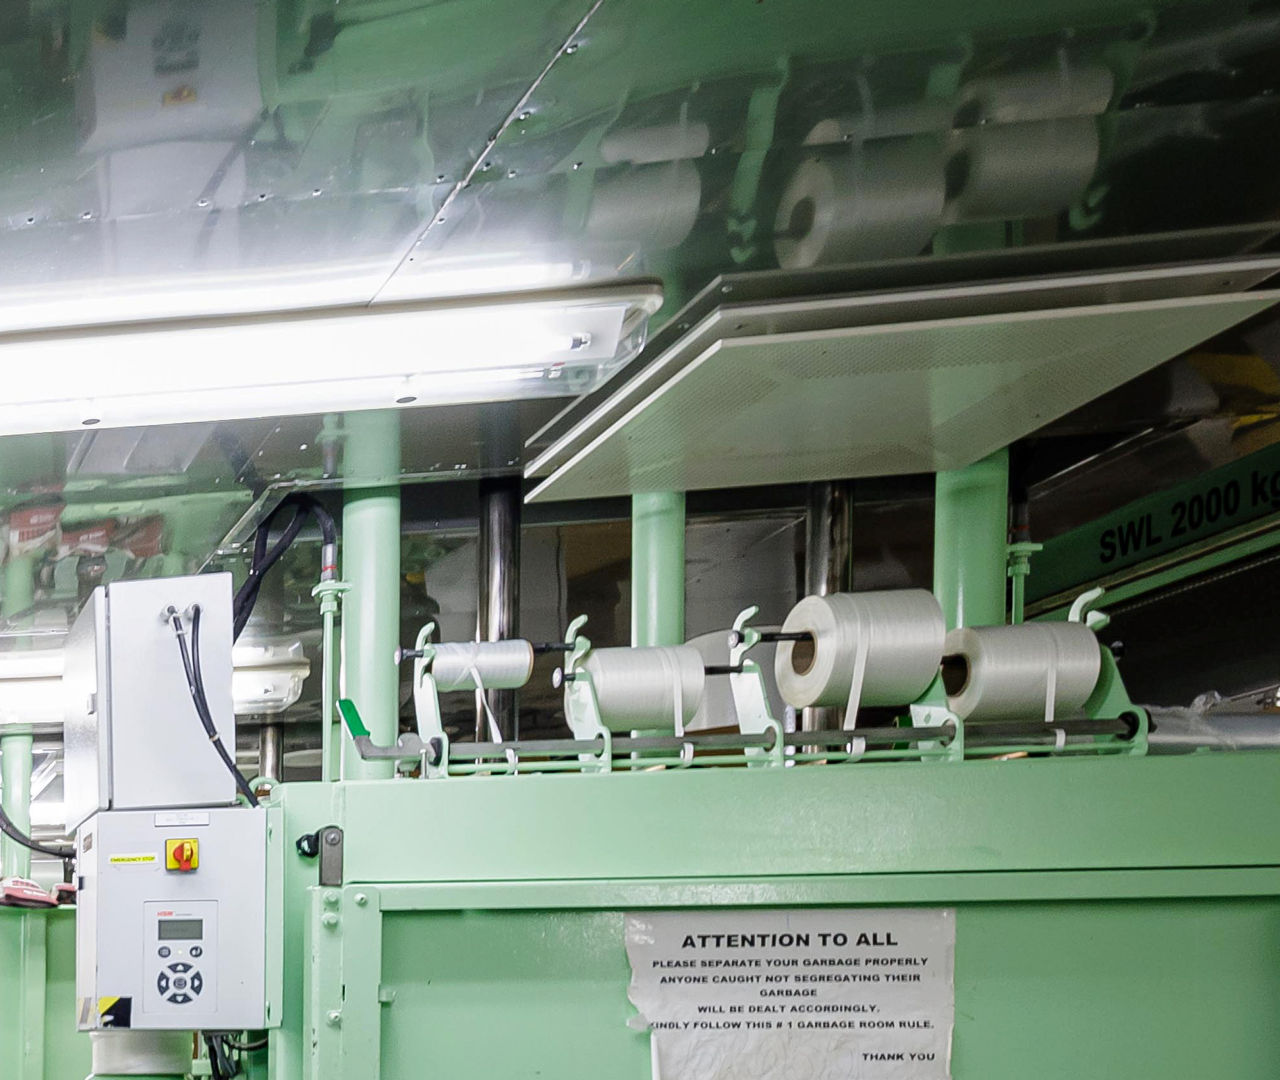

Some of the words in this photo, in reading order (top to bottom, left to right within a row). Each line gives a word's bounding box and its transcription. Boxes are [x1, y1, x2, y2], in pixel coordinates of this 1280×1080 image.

[1099, 513, 1162, 564] SWL
[1171, 479, 1240, 538] 2000
[682, 934, 810, 948] ATTENTION
[818, 933, 847, 947] TO
[856, 932, 898, 946] ALL
[652, 960, 697, 968] PLEASE
[700, 959, 761, 968] SEPARATE
[766, 959, 799, 967] YOUR
[803, 958, 860, 967] GARBAGE
[865, 958, 928, 966] PROPERLY
[660, 976, 708, 984] ANYONE
[712, 975, 761, 983] CAUGHT
[766, 975, 790, 983] NOT
[794, 974, 880, 982] SEGREGATING
[885, 974, 921, 982] THEIR
[760, 989, 817, 997] GARBAGE
[698, 1006, 725, 1014] WILL
[730, 1005, 744, 1013] BE
[749, 1005, 785, 1013] DEALT
[693, 1021, 742, 1029] FOLLOW
[746, 1021, 773, 1029] THIS
[776, 1021, 783, 1029] #
[787, 1021, 793, 1029] 1
[798, 1021, 855, 1029] GARBAGE
[859, 1020, 895, 1029] ROOM
[862, 1053, 904, 1061] THANK
[910, 1053, 936, 1061] YOU
